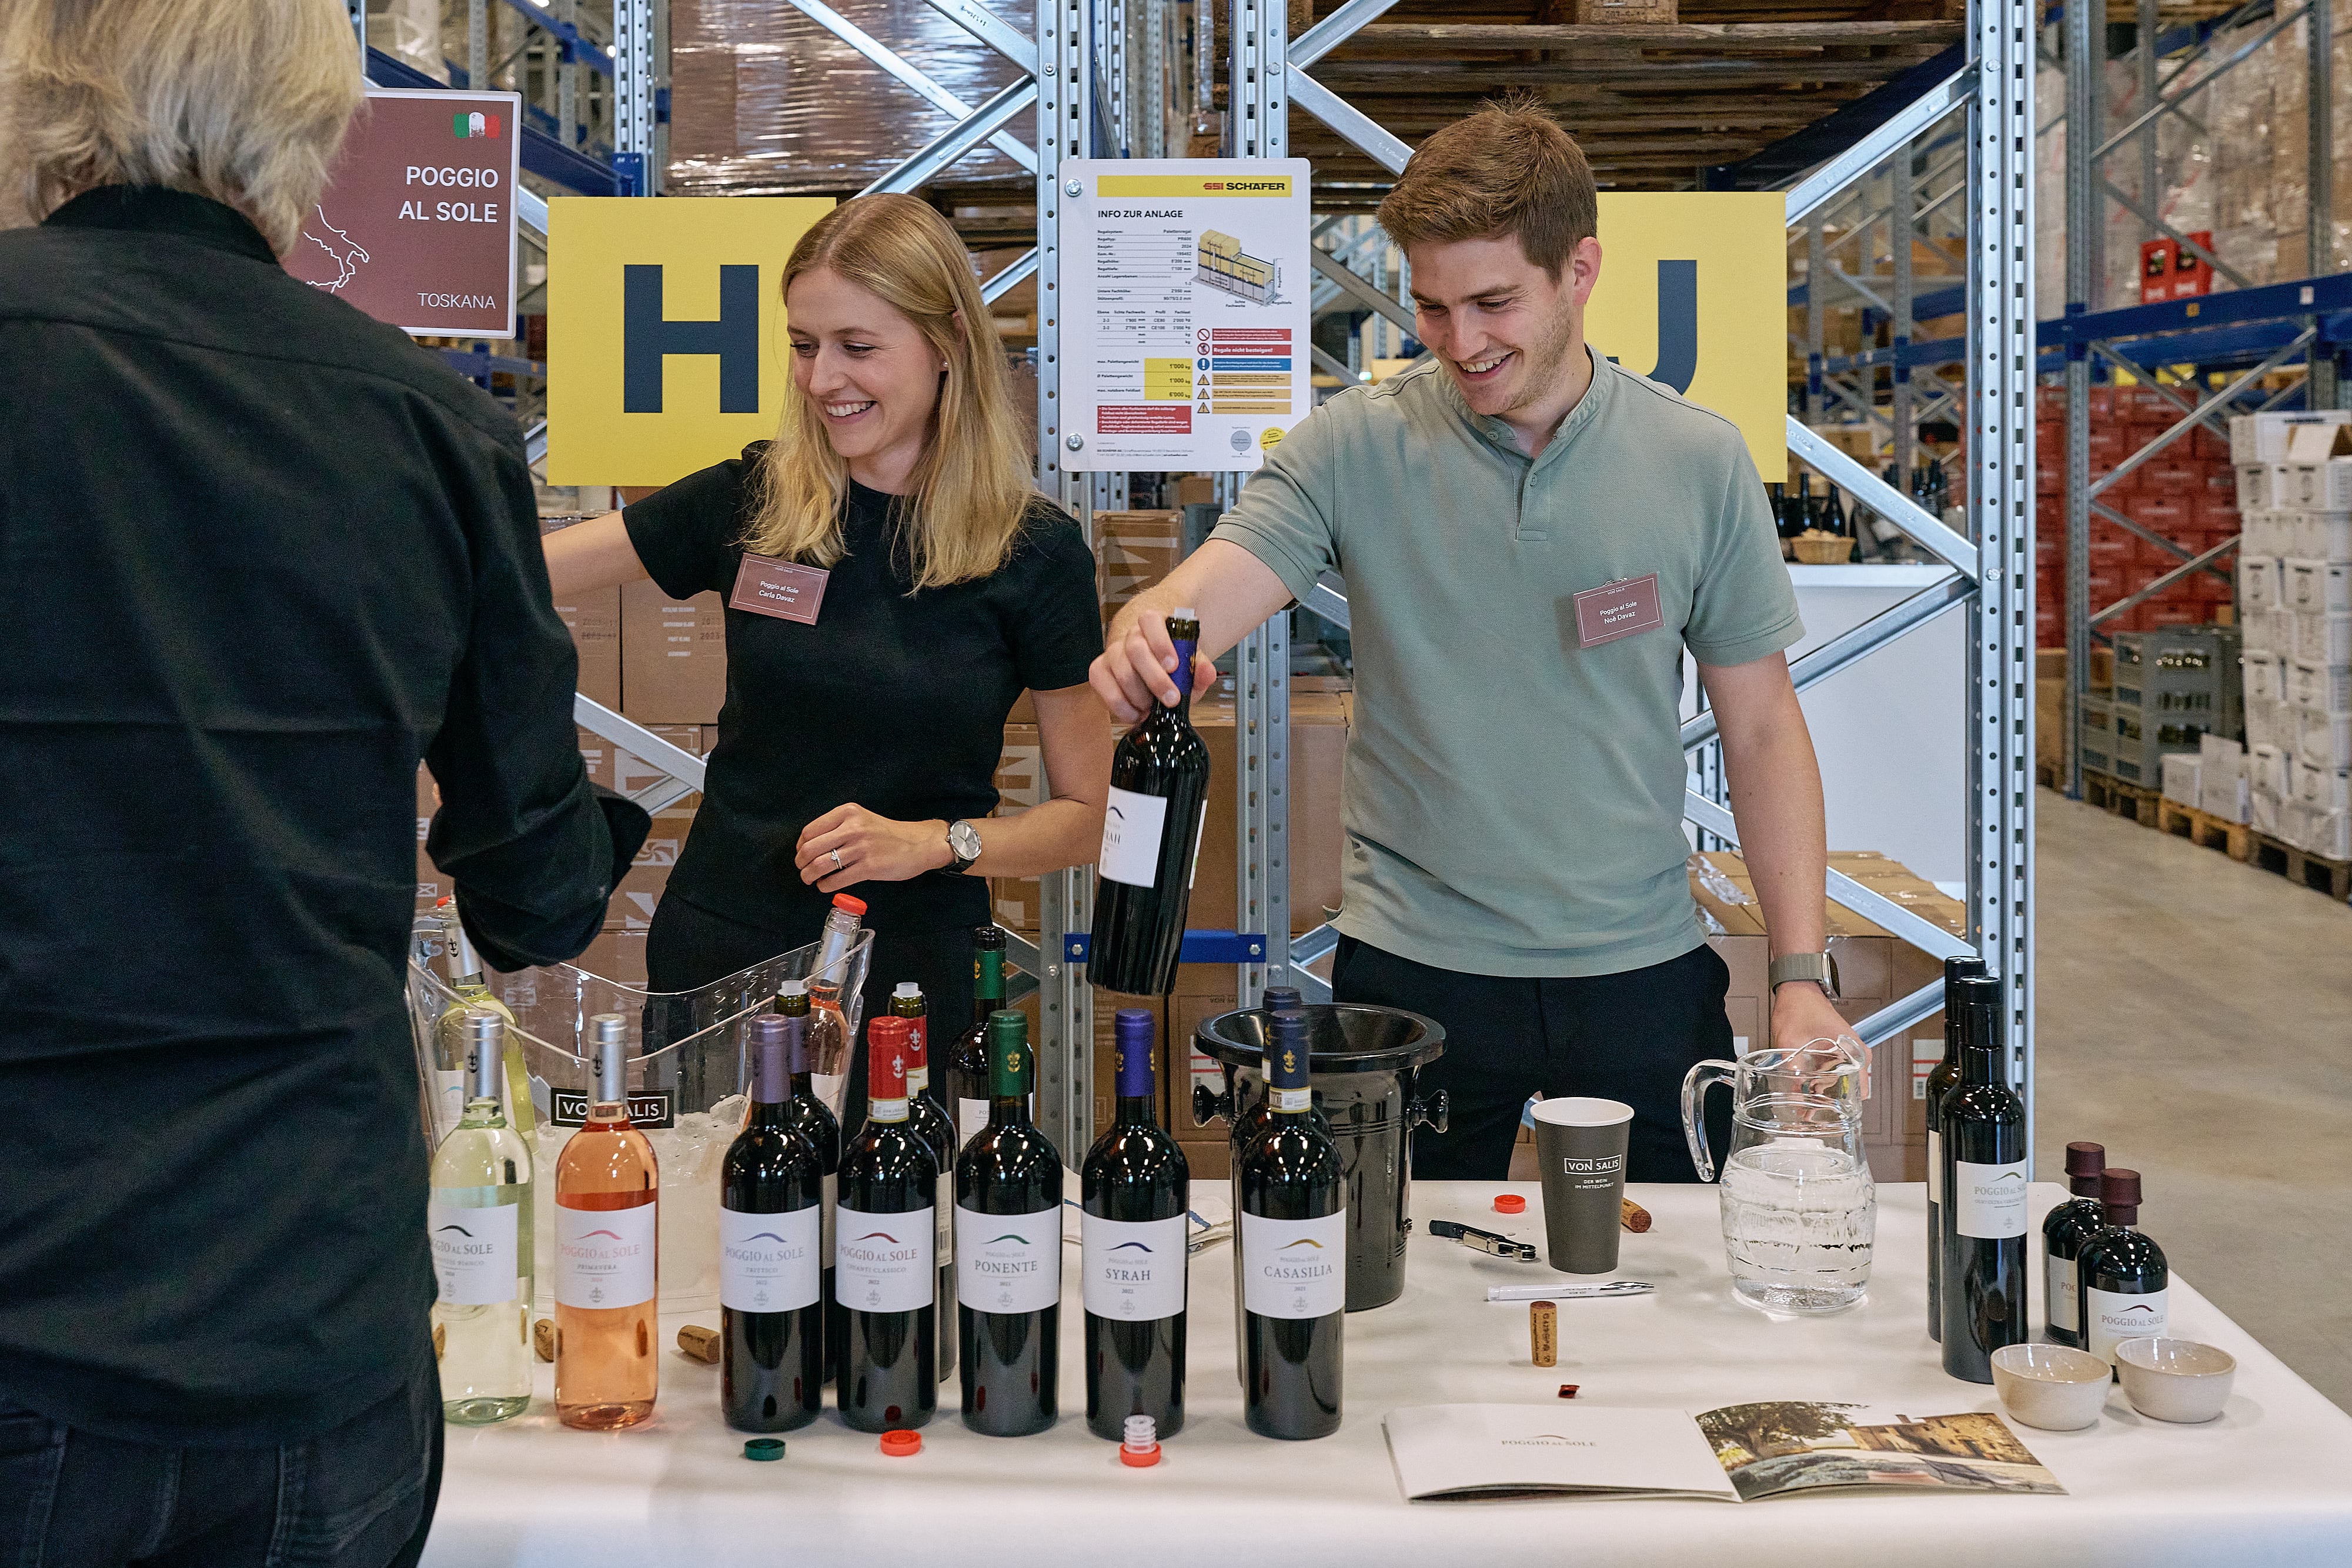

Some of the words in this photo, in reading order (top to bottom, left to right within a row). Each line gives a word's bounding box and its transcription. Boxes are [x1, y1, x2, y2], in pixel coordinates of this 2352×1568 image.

[406, 166, 499, 188] POGGIO
[398, 200, 430, 220] AL
[436, 202, 498, 223] SOLE
[417, 292, 496, 309] TOSKANA
[1608, 260, 1698, 396] J
[624, 265, 759, 413] H
[760, 581, 780, 590] Poggio
[759, 590, 775, 599] Carla
[776, 593, 795, 603] Davaz
[1599, 607, 1619, 616] Poggio
[1625, 601, 1638, 609] Sole
[1603, 616, 1616, 624] Noè
[1617, 611, 1636, 621] Davaz
[562, 1101, 587, 1116] VO
[627, 1103, 660, 1117] ALIS
[1568, 1161, 1592, 1171] VON
[1595, 1159, 1619, 1171] SALIS
[1975, 1186, 2009, 1196] POGGIO
[463, 1243, 493, 1255] SOLE
[560, 1243, 597, 1259] POGGIO
[612, 1244, 641, 1258] SOLE
[726, 1246, 762, 1261] POGGIO
[777, 1247, 805, 1261] SOLE
[840, 1245, 875, 1261] POGGIO
[876, 1253, 887, 1262] AL
[890, 1248, 917, 1262] SOLE
[975, 1259, 1038, 1273] PONENTE
[1264, 1264, 1332, 1278] CASASILIA
[1105, 1268, 1151, 1281] SYRAH
[2102, 1315, 2137, 1326] POGGIO
[2148, 1315, 2164, 1326] SOLE
